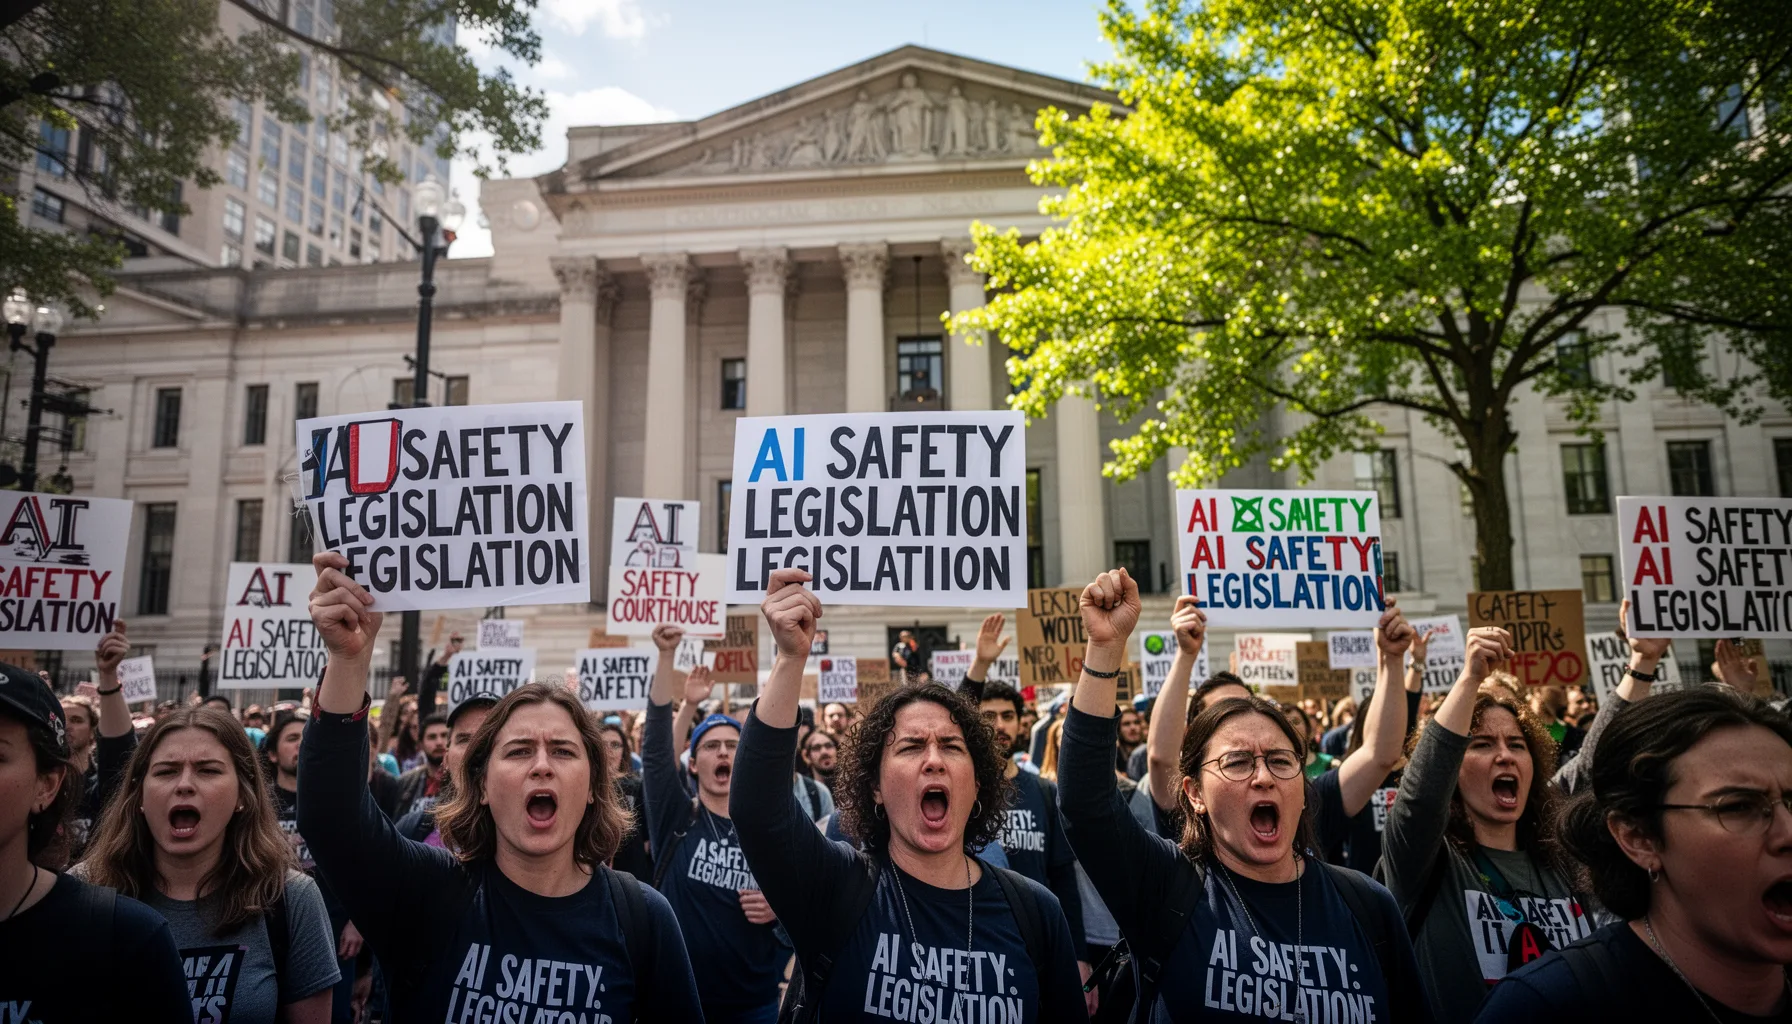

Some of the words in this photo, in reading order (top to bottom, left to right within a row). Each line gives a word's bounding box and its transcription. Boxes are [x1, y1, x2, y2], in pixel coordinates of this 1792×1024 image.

[402, 423, 573, 481] SAFETY
[748, 427, 805, 482] AI
[826, 425, 1015, 480] SAFETY
[318, 482, 573, 549] LEGISLATION
[625, 502, 684, 545] AI
[745, 485, 1020, 539] LEGISLATION
[1187, 498, 1218, 533] AI
[1633, 506, 1669, 543] AI
[330, 538, 580, 593] EGISLATION
[1191, 536, 1226, 569] AI
[1246, 535, 1375, 572] SAFETY
[1633, 546, 1673, 585] AI
[1696, 547, 1792, 587] SAFET
[236, 566, 293, 607] AI
[621, 570, 700, 597] SAFETY
[1187, 572, 1386, 611] LEGISLATION
[612, 598, 719, 625] COURTHOUSE
[226, 618, 253, 648] AI
[456, 659, 472, 677] AI
[476, 658, 522, 676] SAFETY
[580, 657, 597, 675] AI
[603, 656, 649, 674] SAFETY
[454, 943, 491, 990] AI
[871, 933, 900, 974] AI
[910, 942, 1018, 996] SAFETY:
[1209, 928, 1237, 970] AI
[1250, 936, 1358, 989] SAFETY:
